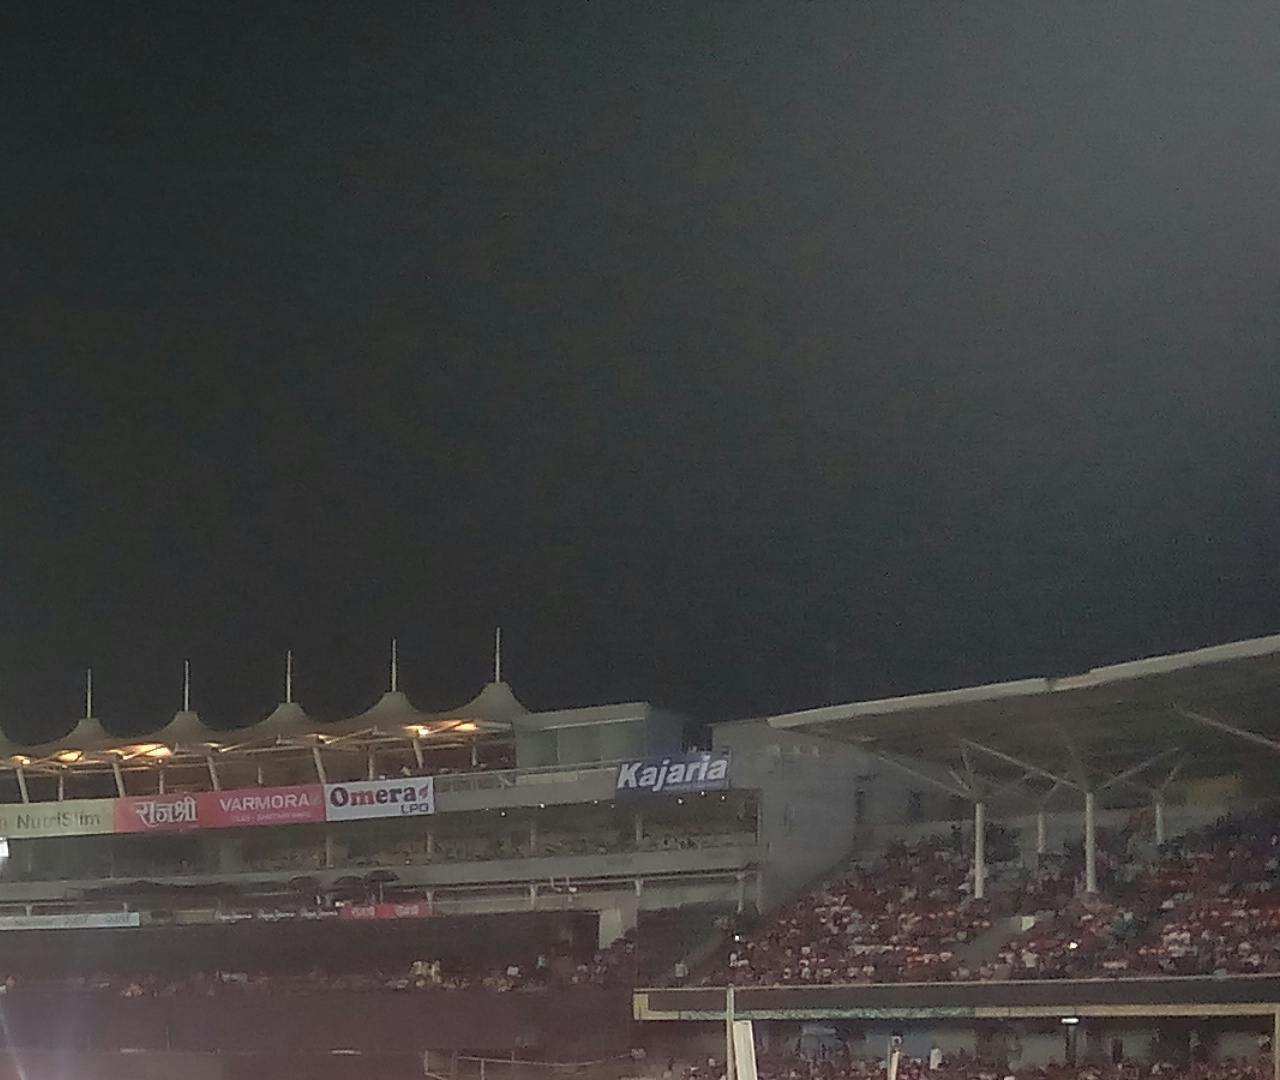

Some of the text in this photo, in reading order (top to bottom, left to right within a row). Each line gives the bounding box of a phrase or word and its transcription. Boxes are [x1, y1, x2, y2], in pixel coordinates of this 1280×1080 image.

[617, 755, 728, 792] Kajaria
[219, 793, 310, 813] VARMORA
[330, 786, 416, 807] Omera
[17, 811, 101, 830] NutriSlim
